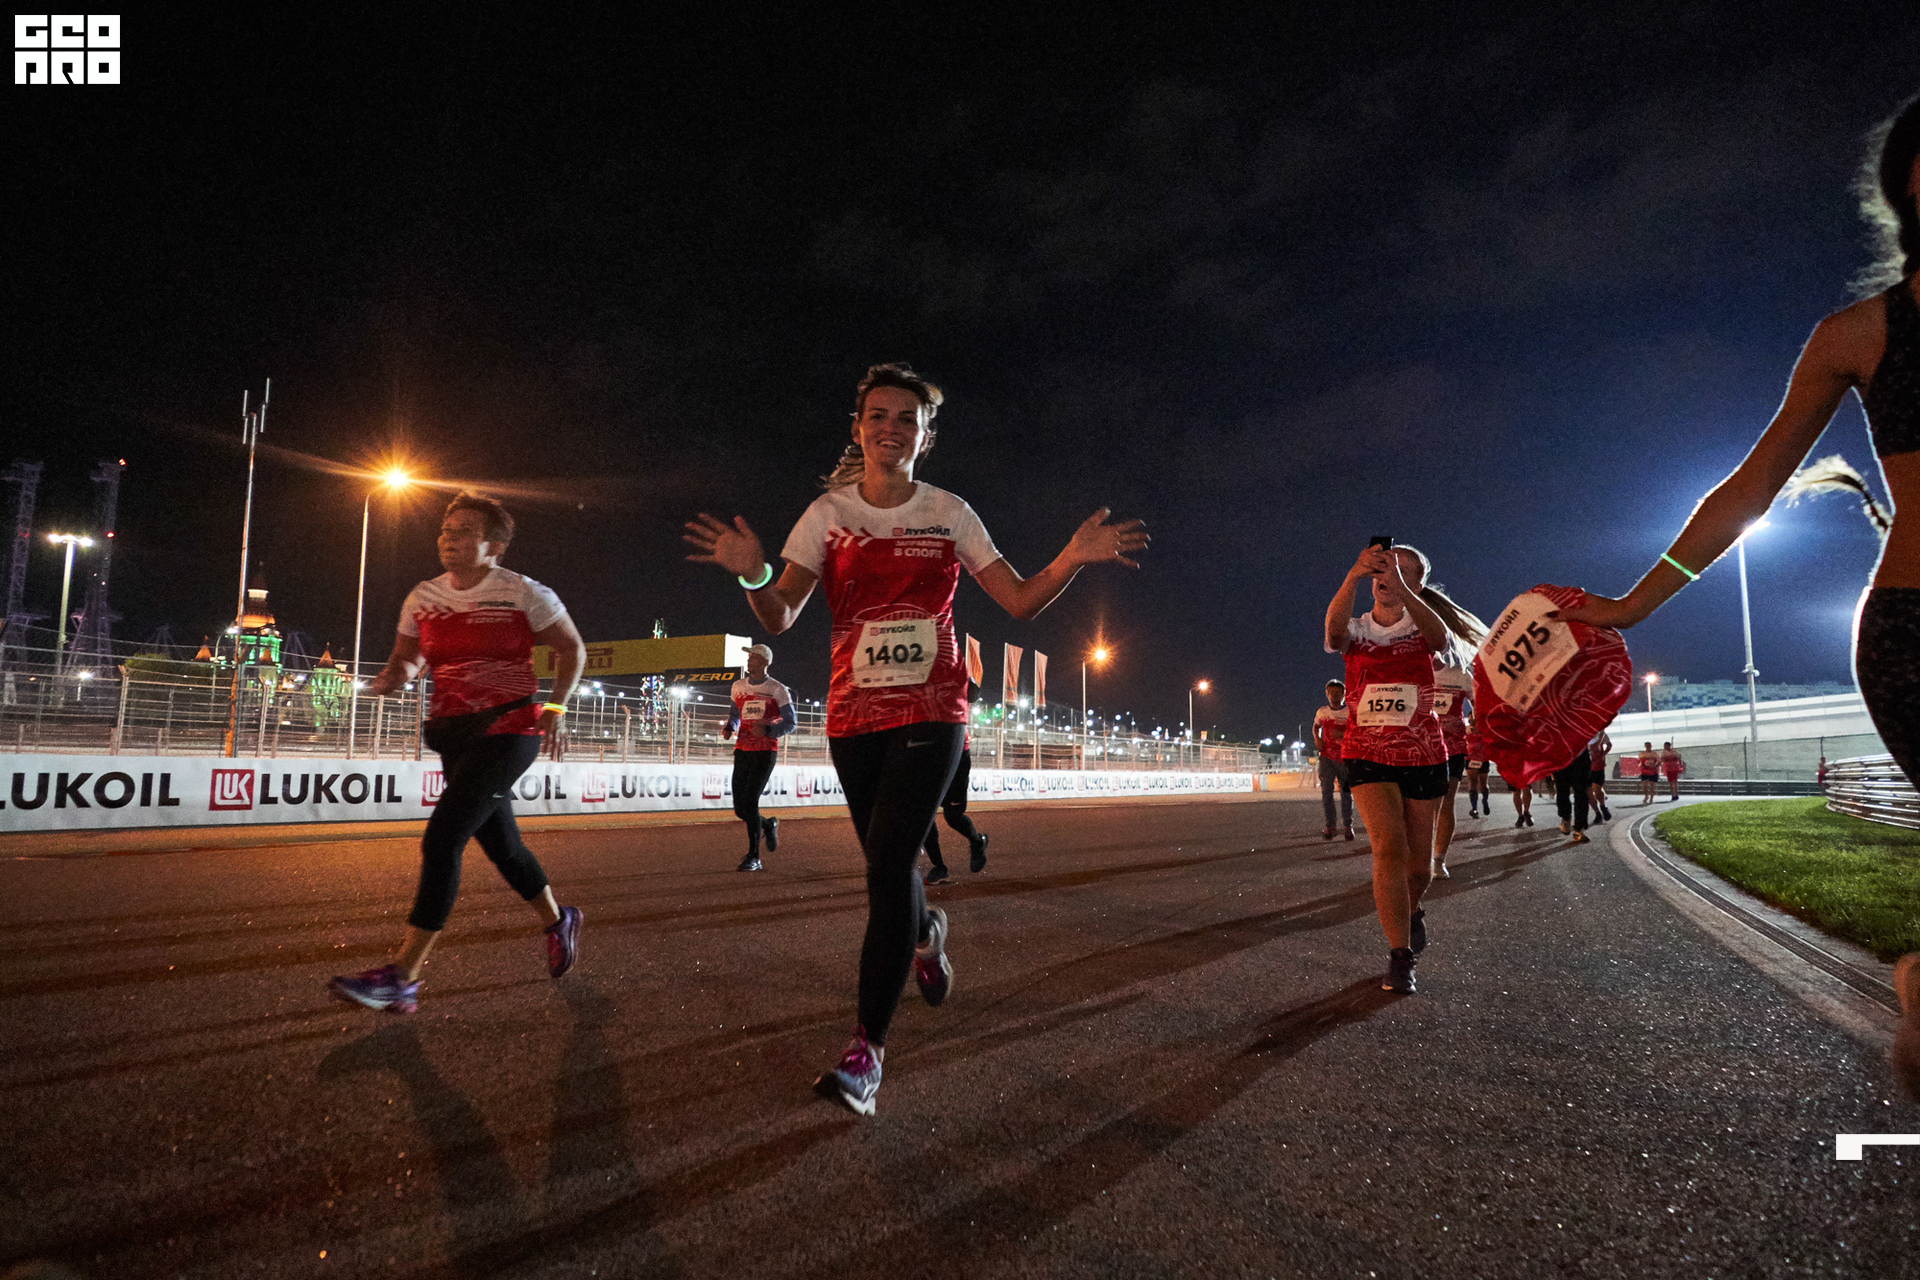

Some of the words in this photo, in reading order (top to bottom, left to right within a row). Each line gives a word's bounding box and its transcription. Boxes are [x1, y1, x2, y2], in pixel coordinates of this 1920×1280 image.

[904, 525, 950, 536] ЛУКОЙЛ
[1490, 609, 1520, 646] ЛУКОЙЛ
[866, 643, 924, 665] 1402
[1498, 621, 1551, 680] 1975
[673, 674, 685, 682] P
[688, 672, 735, 682] ZERO
[1368, 699, 1406, 712] 1576
[1434, 700, 1447, 708] 84
[0, 771, 181, 810] UKOIL
[259, 772, 403, 805] LUKOIL
[510, 774, 567, 801] OIL
[608, 775, 691, 798] LUKOIL
[813, 776, 844, 794] LUK
